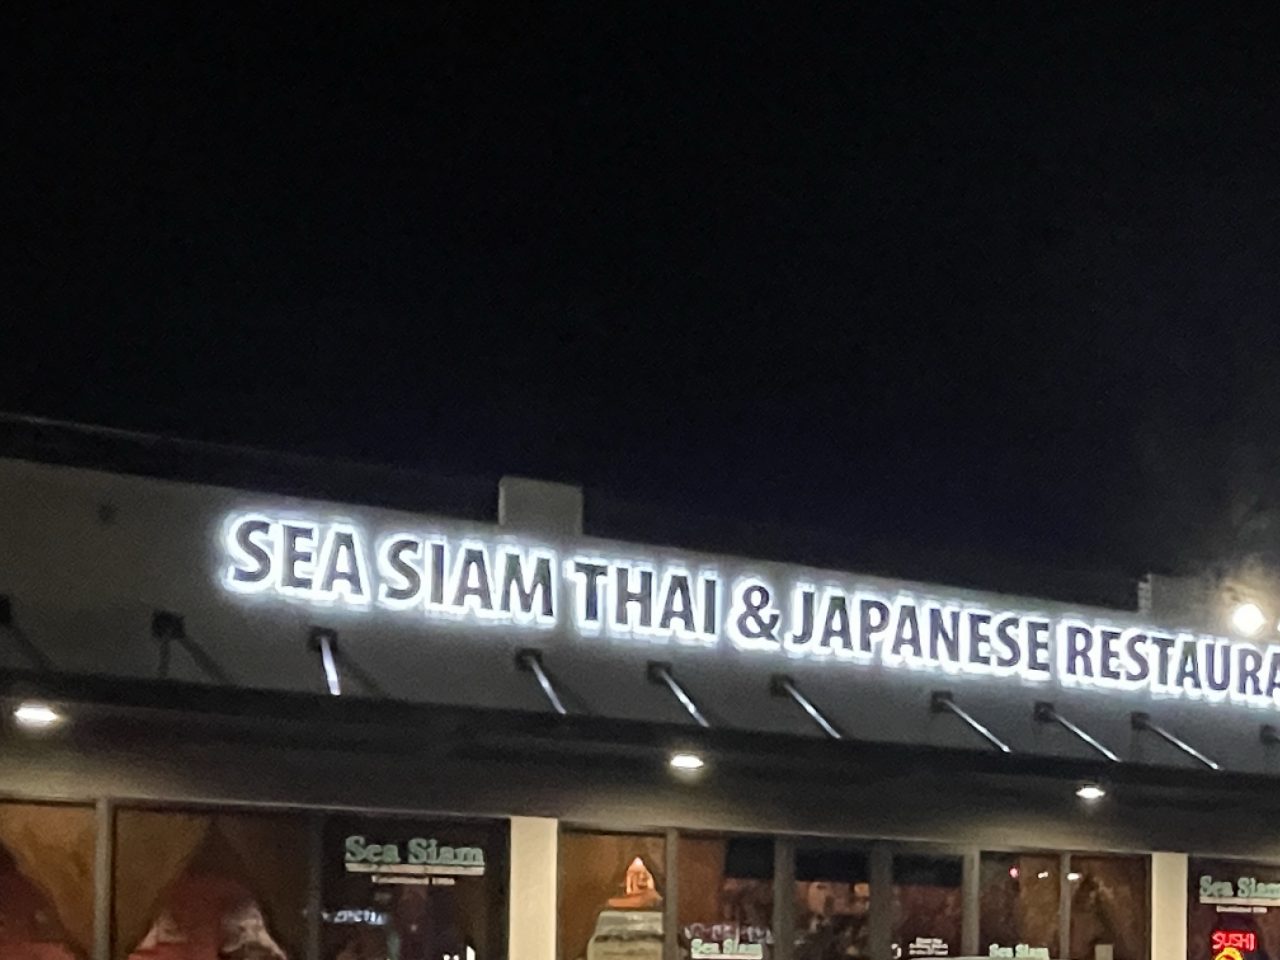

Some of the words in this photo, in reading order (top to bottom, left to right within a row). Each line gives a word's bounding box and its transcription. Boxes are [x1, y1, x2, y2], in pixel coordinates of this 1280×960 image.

[231, 518, 364, 597] SEA
[384, 537, 556, 617] SIAM
[572, 559, 718, 636] THAI
[735, 583, 780, 642] &
[791, 588, 1051, 672] JAPANESE
[1212, 932, 1255, 951] SUSHI
